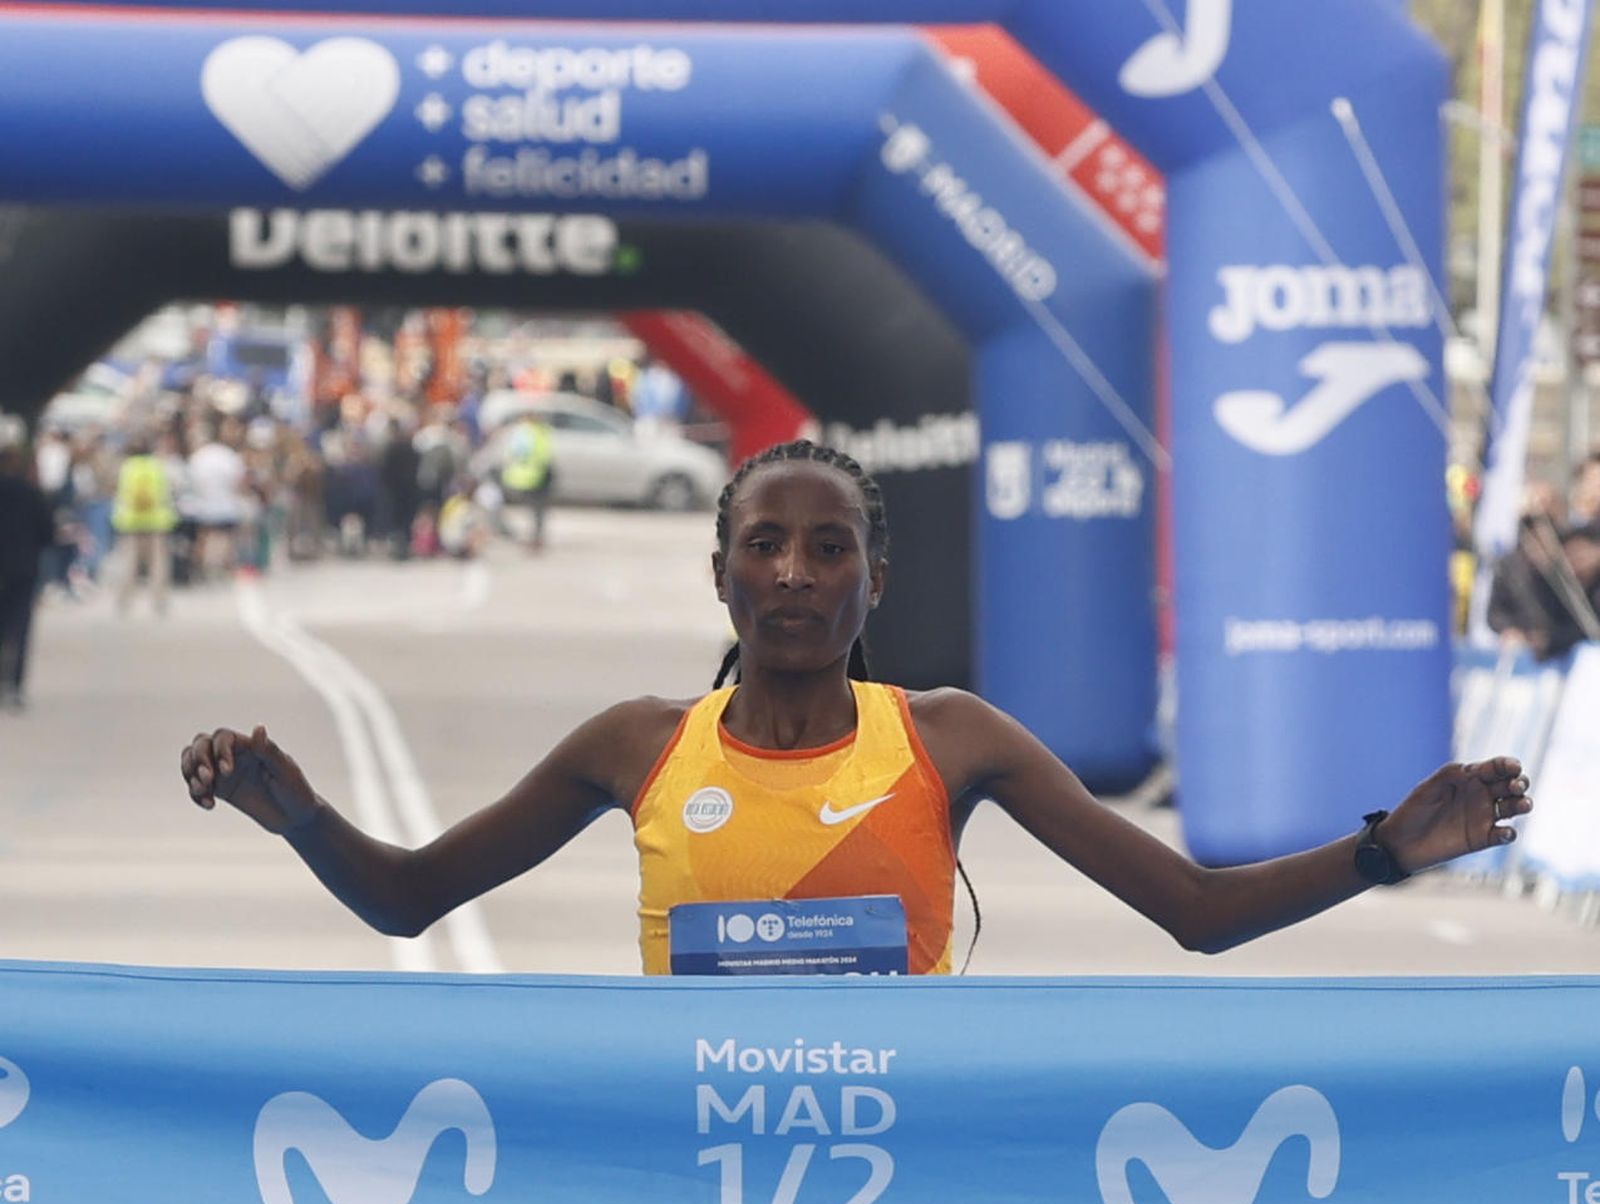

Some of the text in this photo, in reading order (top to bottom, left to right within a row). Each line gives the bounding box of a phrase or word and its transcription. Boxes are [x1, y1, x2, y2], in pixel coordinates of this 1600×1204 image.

[463, 42, 692, 91] deporte
[463, 91, 621, 141] salud
[463, 146, 708, 198] felicidad
[786, 914, 854, 928] Telefónica
[695, 1037, 897, 1075] Movistar
[696, 1083, 897, 1136] MAD
